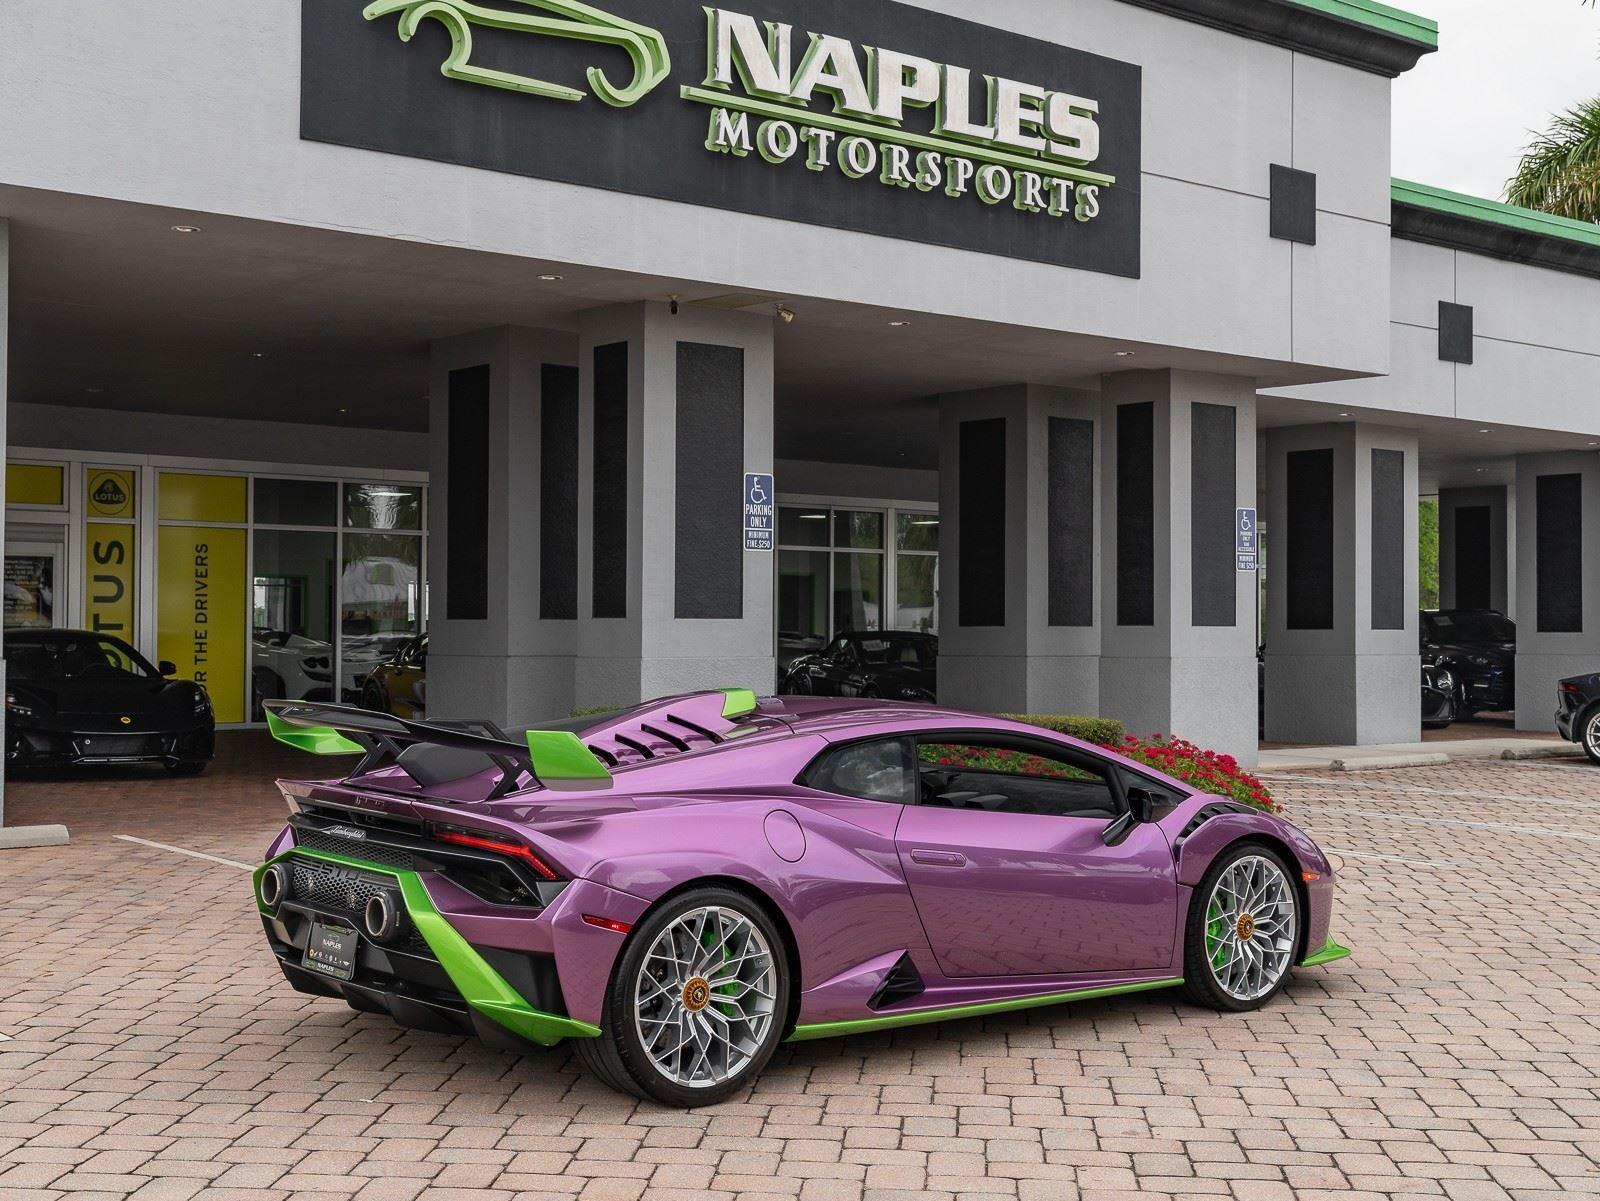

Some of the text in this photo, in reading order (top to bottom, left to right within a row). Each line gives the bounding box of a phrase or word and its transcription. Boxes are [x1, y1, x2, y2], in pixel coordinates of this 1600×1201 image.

[703, 6, 1100, 164] NAPLES
[705, 108, 1100, 222] MOTORSPORTS
[95, 493, 124, 502] LOTUS
[745, 504, 772, 515] PARKING
[750, 517, 767, 528] ONLY
[748, 531, 769, 539] MINIMUM
[747, 540, 771, 549] FINE $250
[195, 543, 209, 624] DRIVERS
[194, 629, 208, 665] THE
[323, 938, 342, 950] NAPLES
[317, 963, 335, 972] NAPLES
